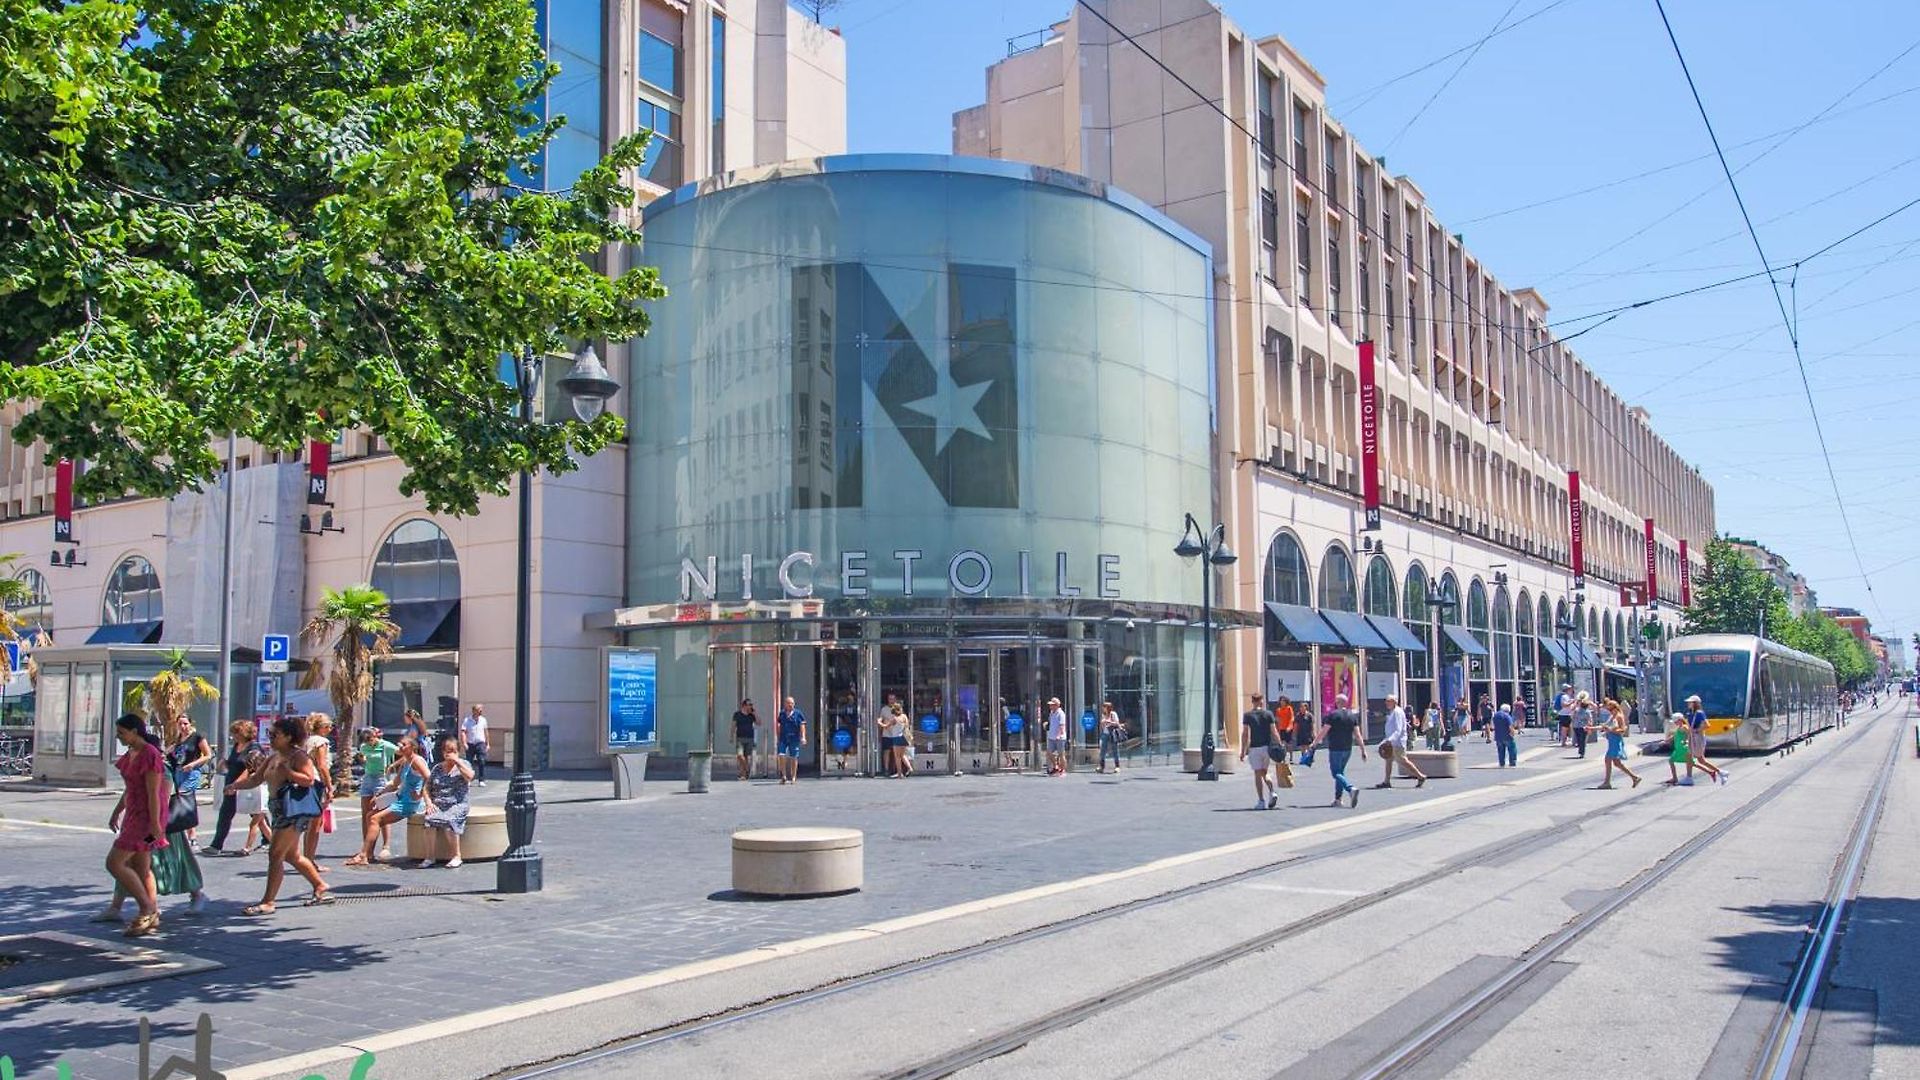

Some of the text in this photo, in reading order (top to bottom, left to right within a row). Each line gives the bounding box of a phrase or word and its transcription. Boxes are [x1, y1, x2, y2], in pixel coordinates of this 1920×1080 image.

[1363, 384, 1375, 454] NICETOILE
[1570, 498, 1580, 542] NICETOILE
[680, 549, 1121, 600] NICETOILE
[270, 640, 282, 657] P
[1471, 660, 1478, 670] P
